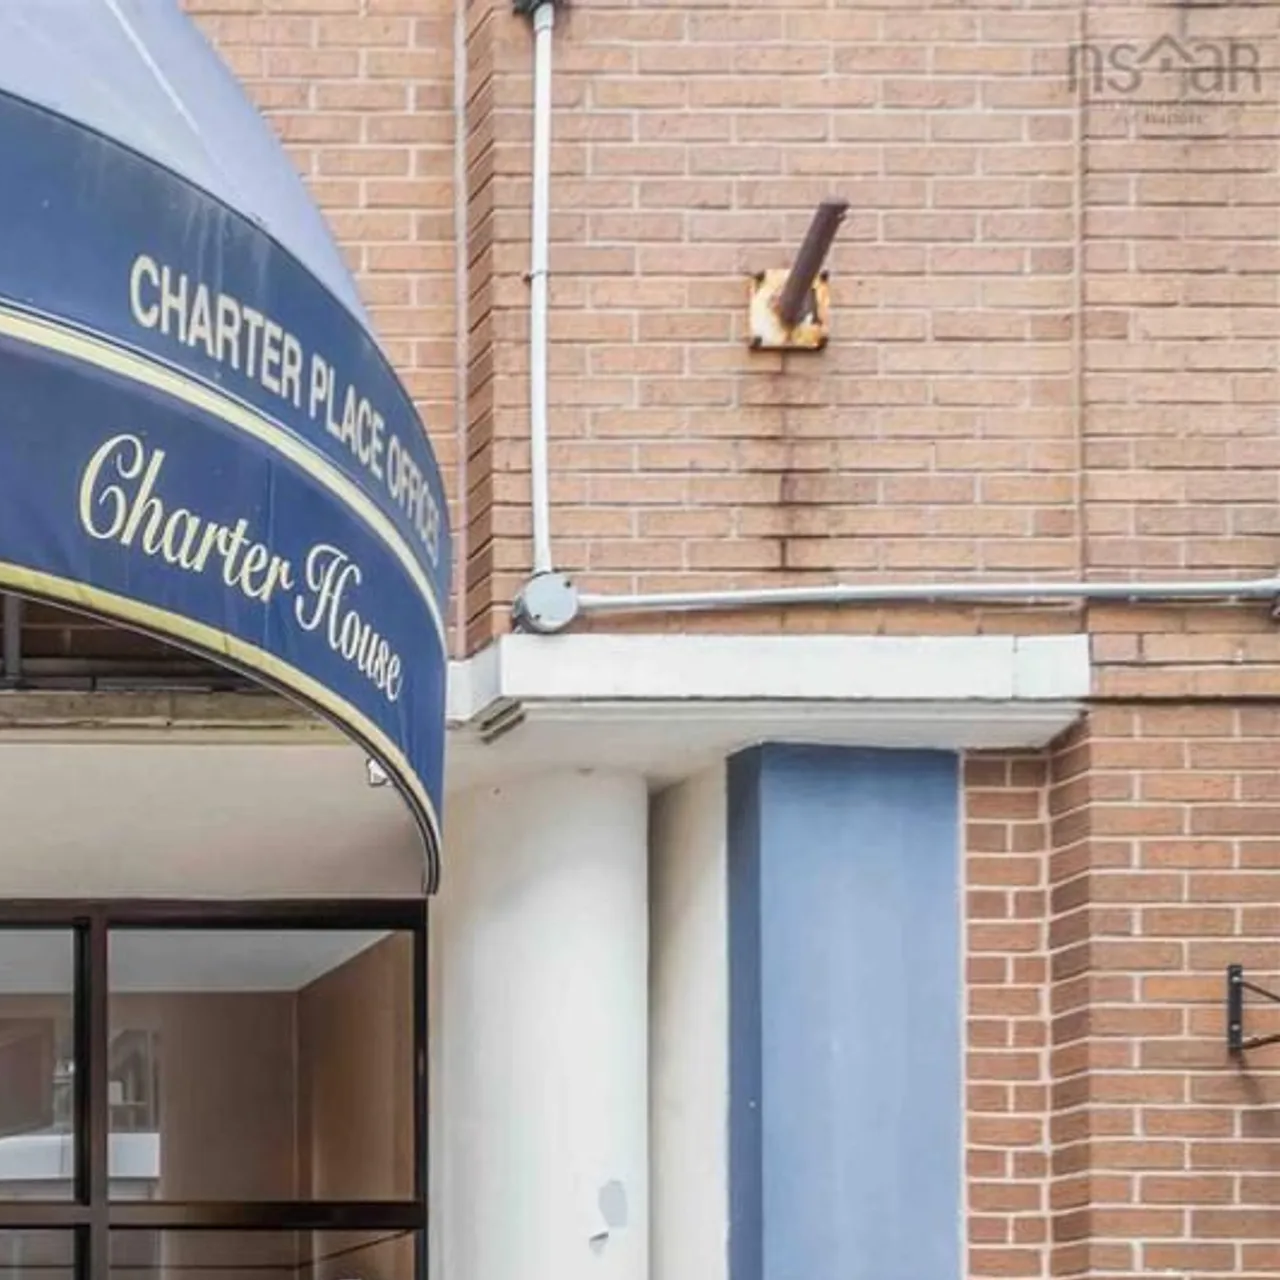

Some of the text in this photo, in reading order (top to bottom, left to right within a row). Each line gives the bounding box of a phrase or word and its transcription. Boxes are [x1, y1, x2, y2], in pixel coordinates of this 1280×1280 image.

[130, 255, 439, 568] CHARTER PLACE OFFICES
[80, 434, 404, 702] Charter House
